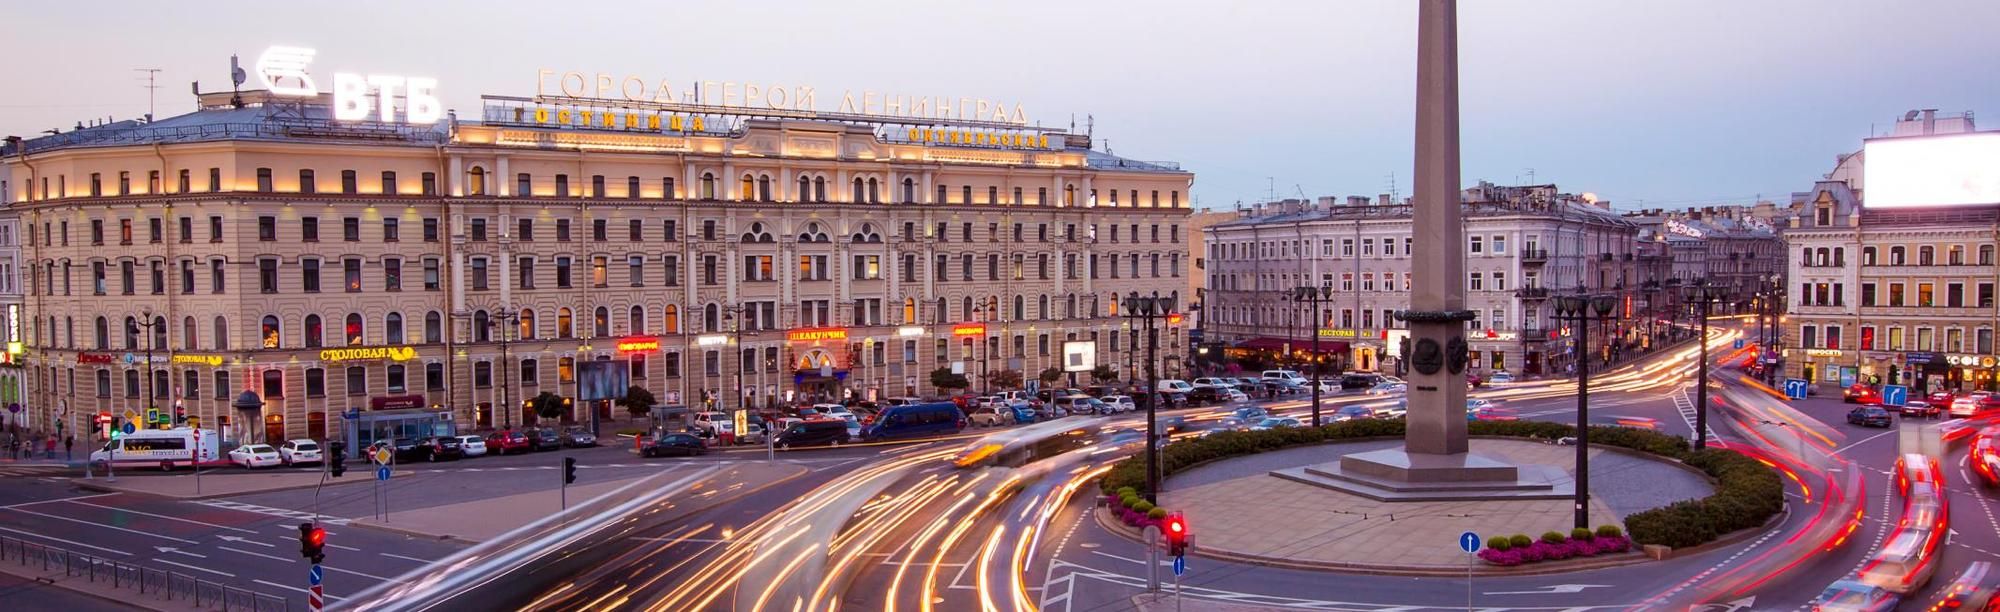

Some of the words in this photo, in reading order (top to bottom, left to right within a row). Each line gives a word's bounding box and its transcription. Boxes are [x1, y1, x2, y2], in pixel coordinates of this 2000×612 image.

[333, 72, 442, 125] ВТБ
[839, 89, 1028, 124] ЛЕНИНГРАД
[515, 107, 704, 132] ГОСТИНИЦА
[908, 127, 1050, 149] ОКТЯБРЬСКАЯ
[320, 349, 386, 361] СТОЛОВАЯ
